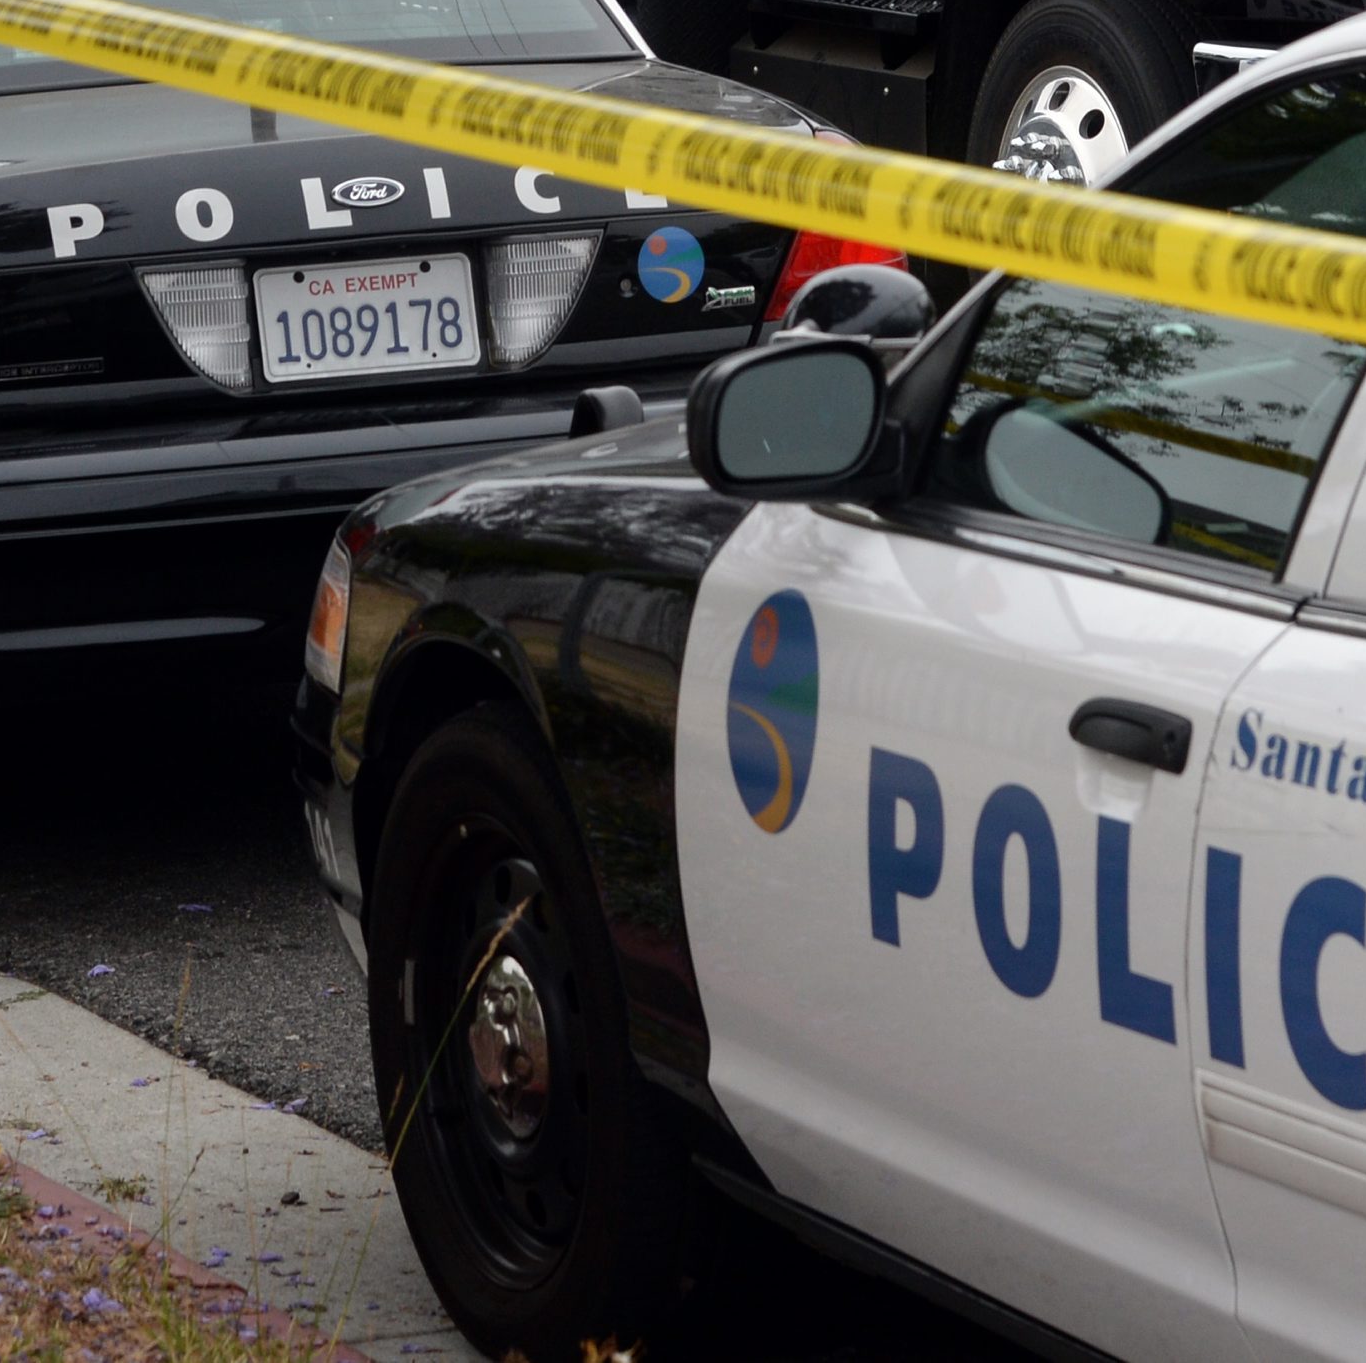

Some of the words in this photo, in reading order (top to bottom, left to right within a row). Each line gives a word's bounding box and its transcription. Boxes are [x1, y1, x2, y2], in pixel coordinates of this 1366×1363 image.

[348, 183, 388, 202] Ford
[308, 279, 335, 296] CA
[345, 272, 419, 294] EXEMPT
[276, 296, 464, 366] 1089178
